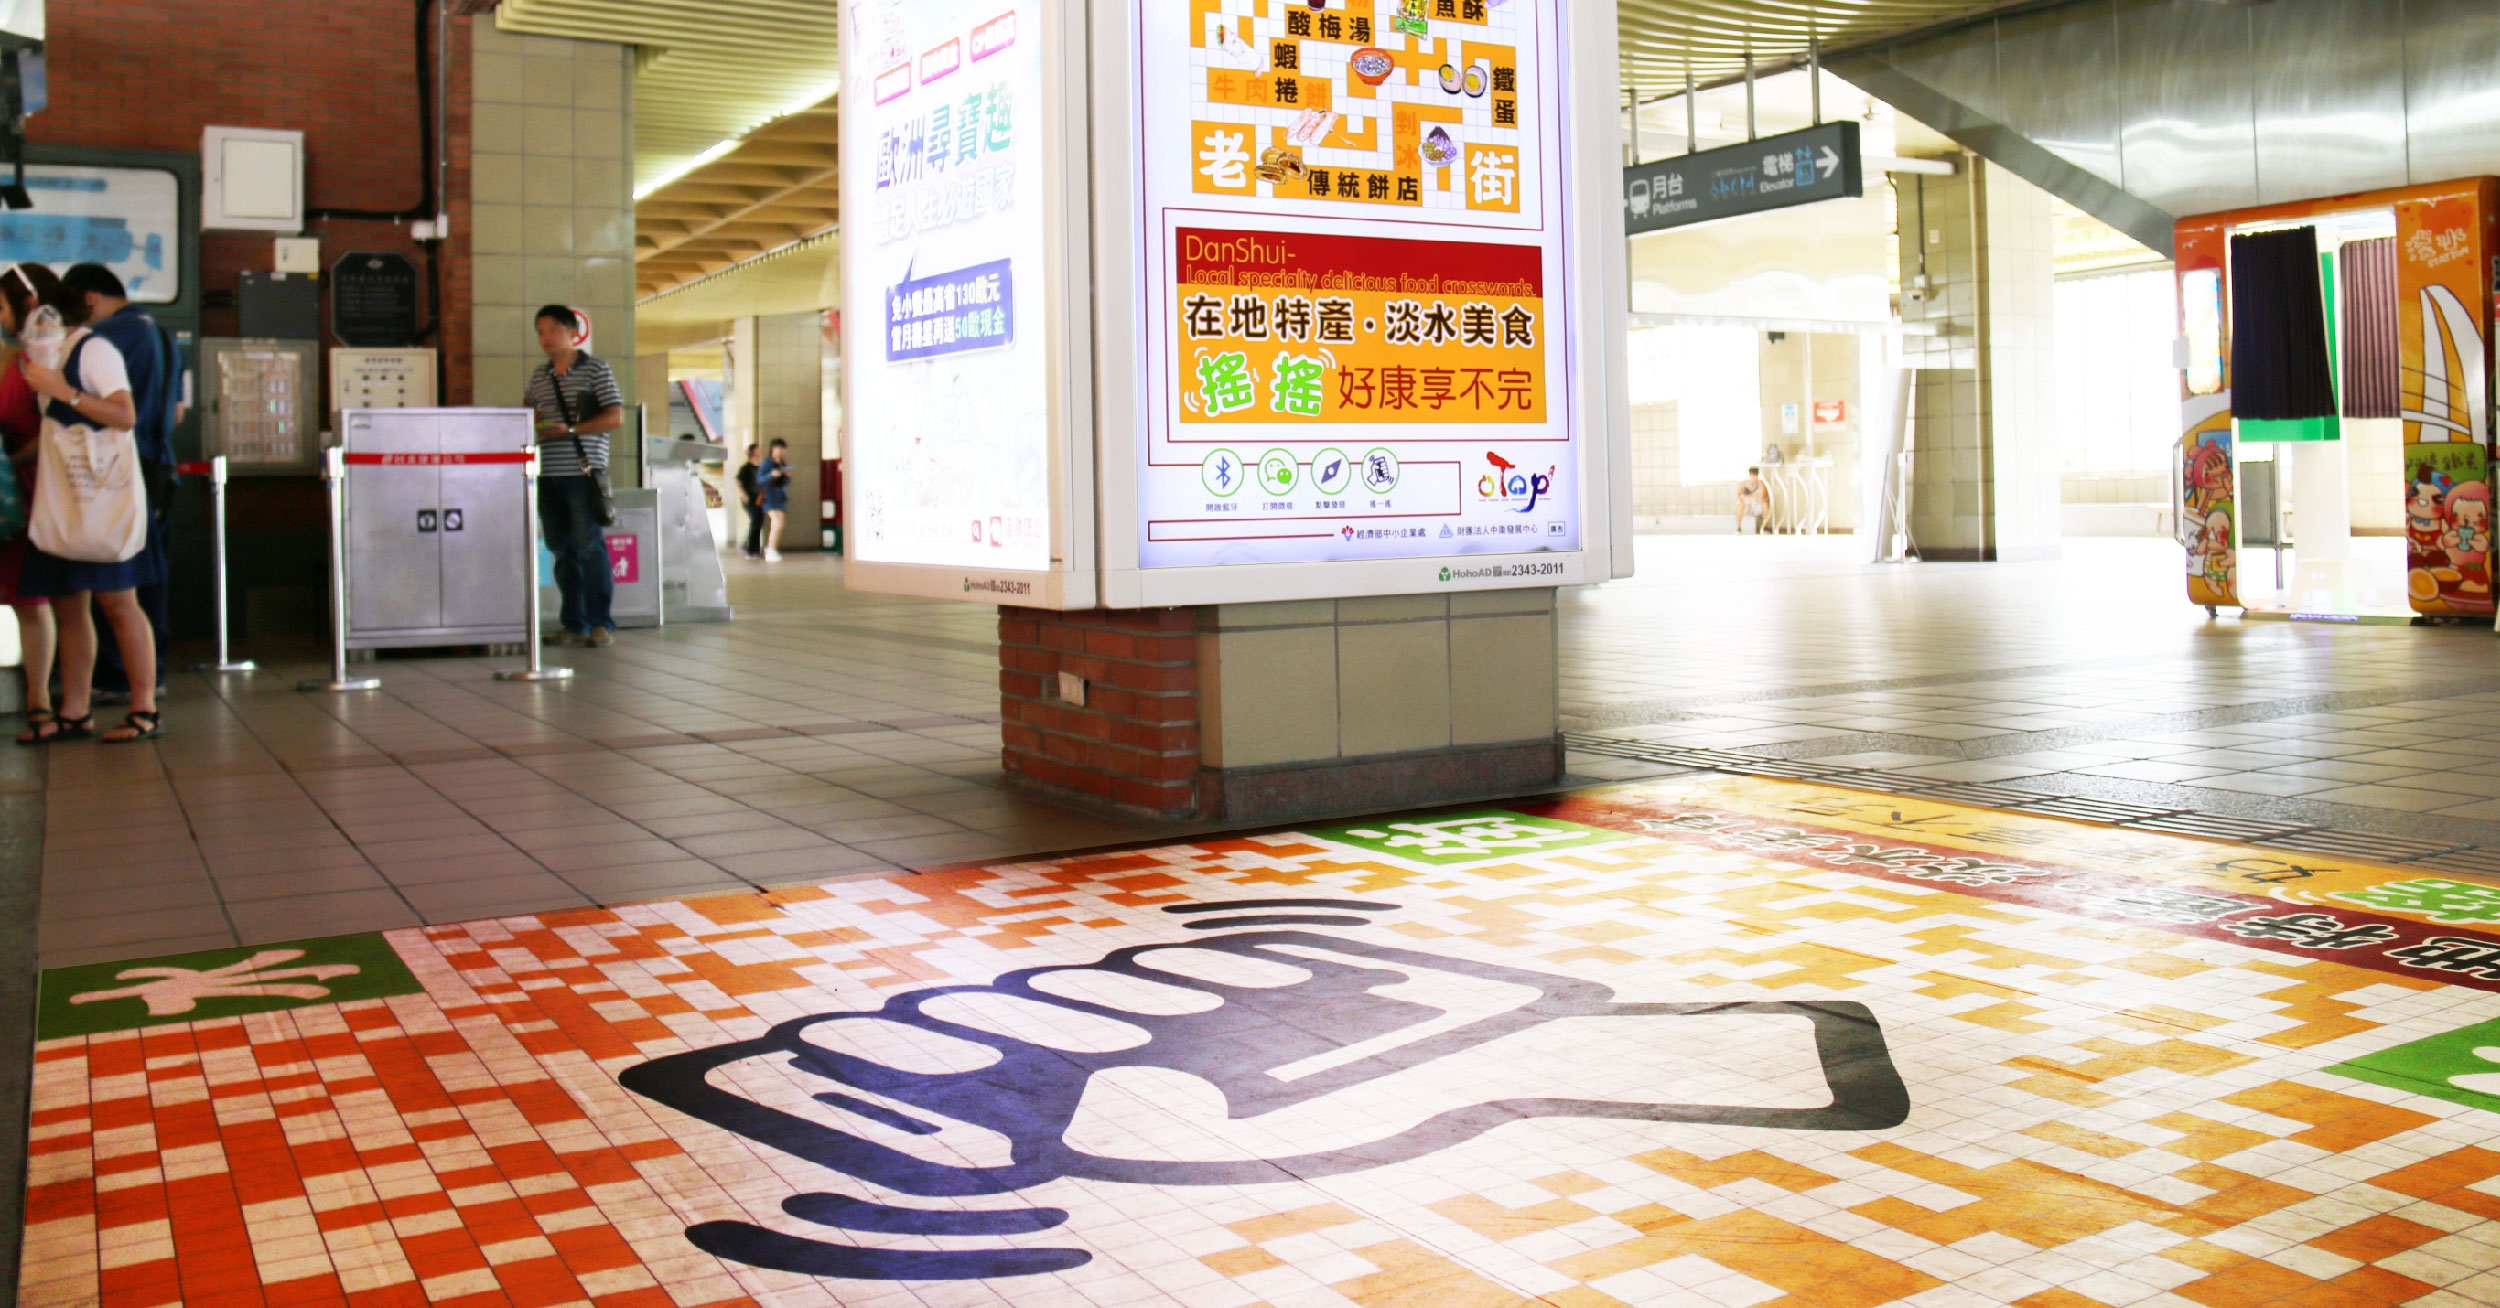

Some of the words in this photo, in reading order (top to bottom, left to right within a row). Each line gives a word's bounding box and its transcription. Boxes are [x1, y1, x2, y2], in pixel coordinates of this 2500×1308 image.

[1287, 11, 1371, 43] 酸梅湯
[1274, 43, 1298, 103] 蝦捲
[1493, 67, 1516, 125] 鐵蛋
[876, 80, 1012, 194] 歐洲尋寶趣
[1199, 130, 1250, 188] 老
[1470, 151, 1515, 206] 街
[1762, 152, 1794, 176] 電梯
[1307, 169, 1418, 201] 傳統餅店
[1653, 172, 1684, 199] 月台
[1760, 177, 1795, 194] Elevator
[1653, 198, 1698, 216] Platforms
[1186, 235, 1296, 264] DanShui-
[1186, 264, 1234, 286] Local
[1238, 267, 1317, 293] specialty
[1321, 270, 1397, 292] delicious
[1400, 273, 1439, 294] food
[1338, 365, 1532, 410] 好康享不完
[1356, 528, 1426, 540] 經濟部中小企業處
[1452, 568, 1493, 579] HohoAD
[1512, 562, 1564, 576] 2343-2011
